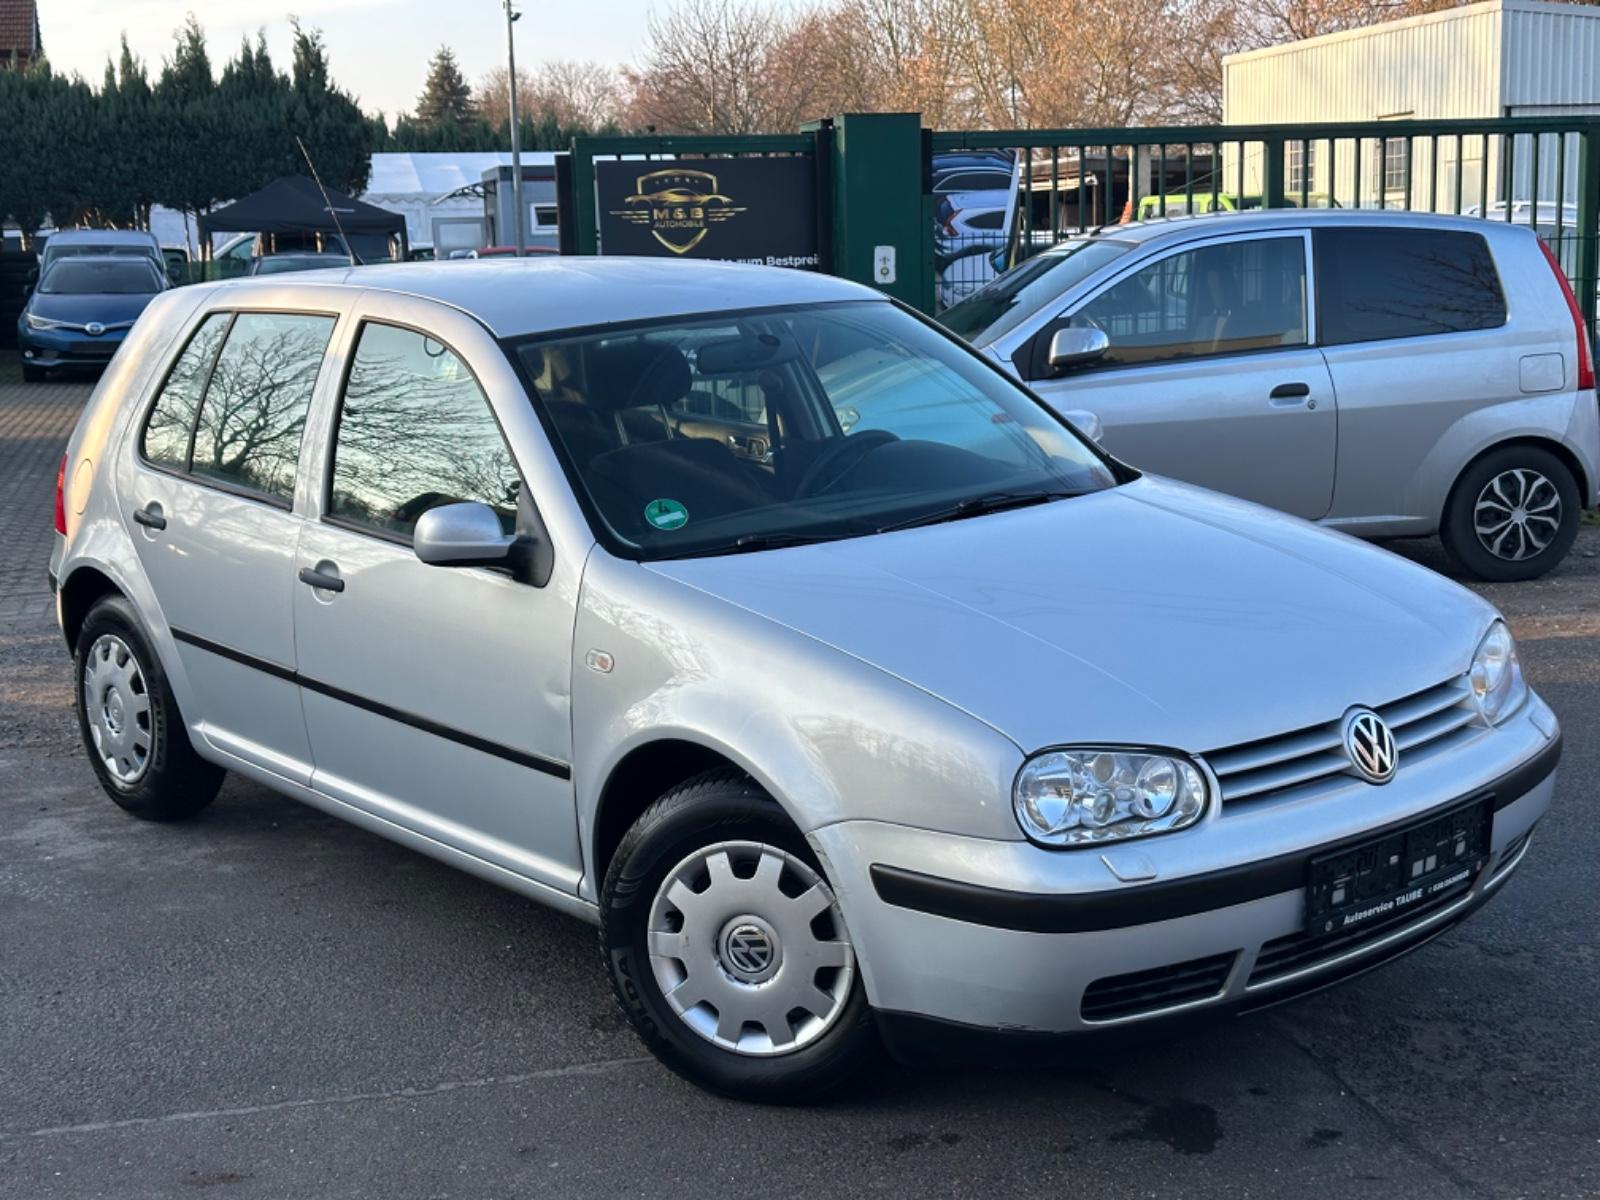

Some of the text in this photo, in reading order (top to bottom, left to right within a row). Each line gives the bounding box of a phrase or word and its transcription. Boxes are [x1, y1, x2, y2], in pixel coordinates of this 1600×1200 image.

[653, 208, 669, 220] M
[673, 208, 687, 219] &
[1343, 888, 1423, 926] Autoservice TAUBE
